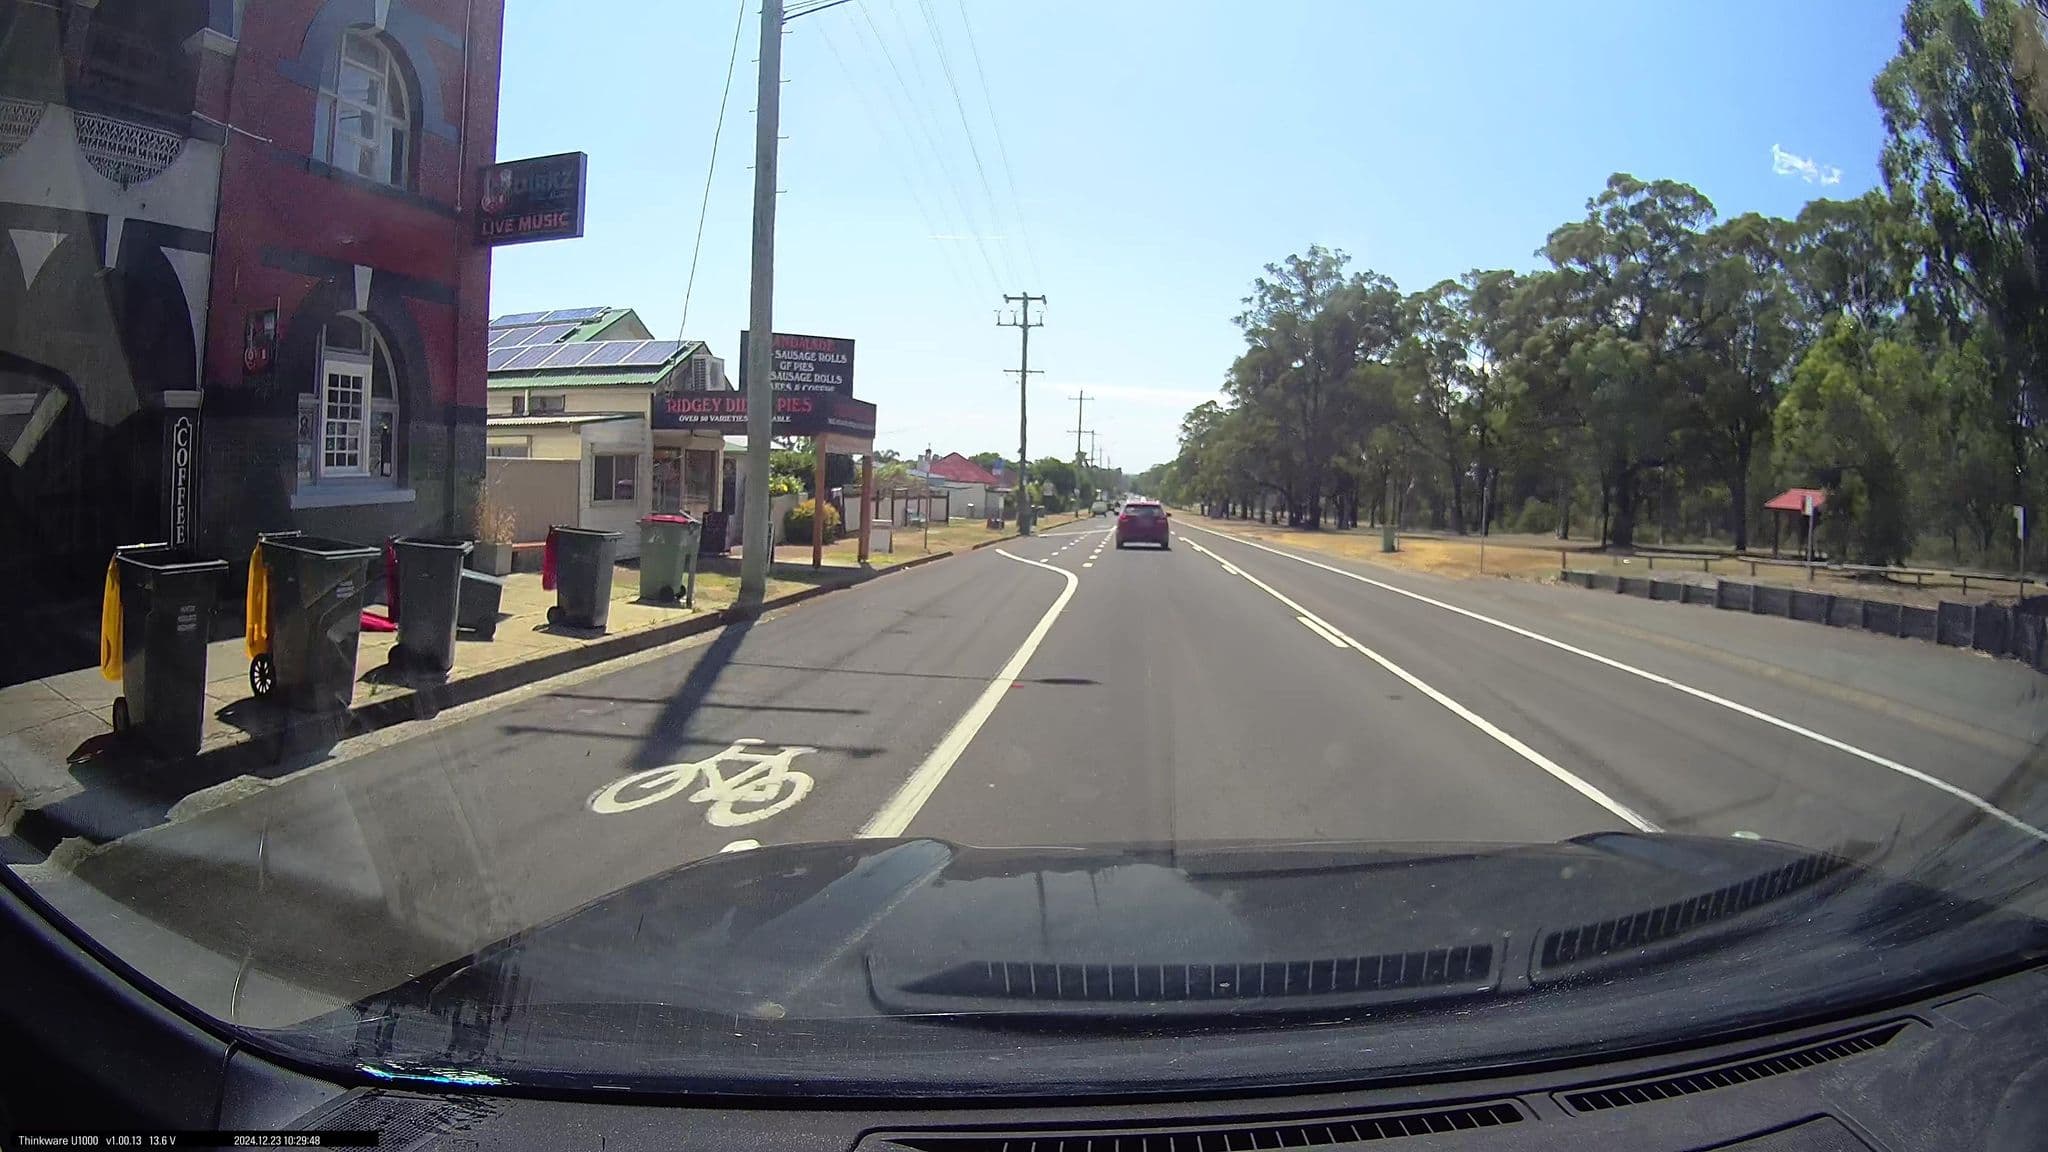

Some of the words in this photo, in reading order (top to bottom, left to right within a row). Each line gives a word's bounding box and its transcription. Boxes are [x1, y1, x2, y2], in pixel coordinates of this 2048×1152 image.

[482, 219, 513, 235] LIVE
[518, 213, 569, 232] MUSIC
[775, 350, 817, 362] SAUSAGE
[818, 353, 847, 364] ROLLS
[780, 361, 792, 371] GF
[793, 362, 814, 372] PIES
[769, 371, 813, 382] SAUSAGE
[814, 374, 843, 385] ROLLS
[665, 397, 721, 413] RIDGEY
[778, 397, 813, 413] PIES
[176, 428, 188, 544] COFFEE
